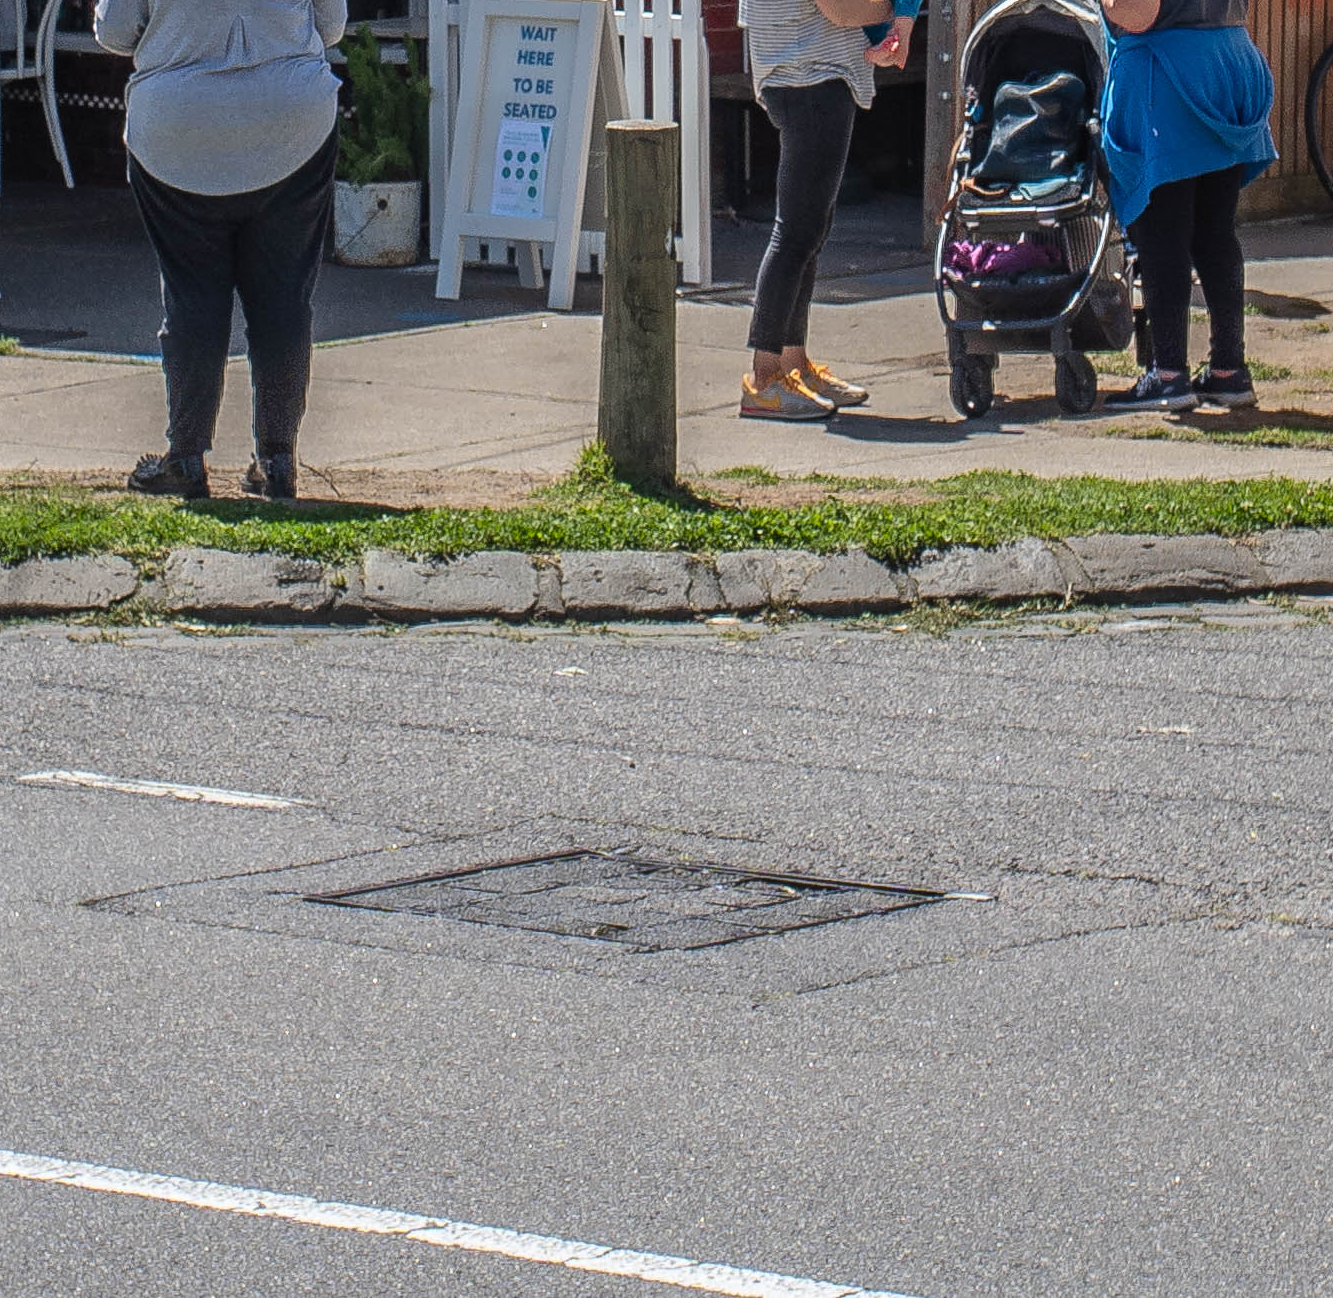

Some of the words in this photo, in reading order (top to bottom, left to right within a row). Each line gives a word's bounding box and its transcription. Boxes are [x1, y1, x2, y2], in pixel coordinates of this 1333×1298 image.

[521, 26, 558, 42] WAIT
[517, 52, 555, 67] HERE
[513, 78, 535, 93] TO
[536, 79, 554, 94] BE
[503, 102, 557, 119] SEATED
